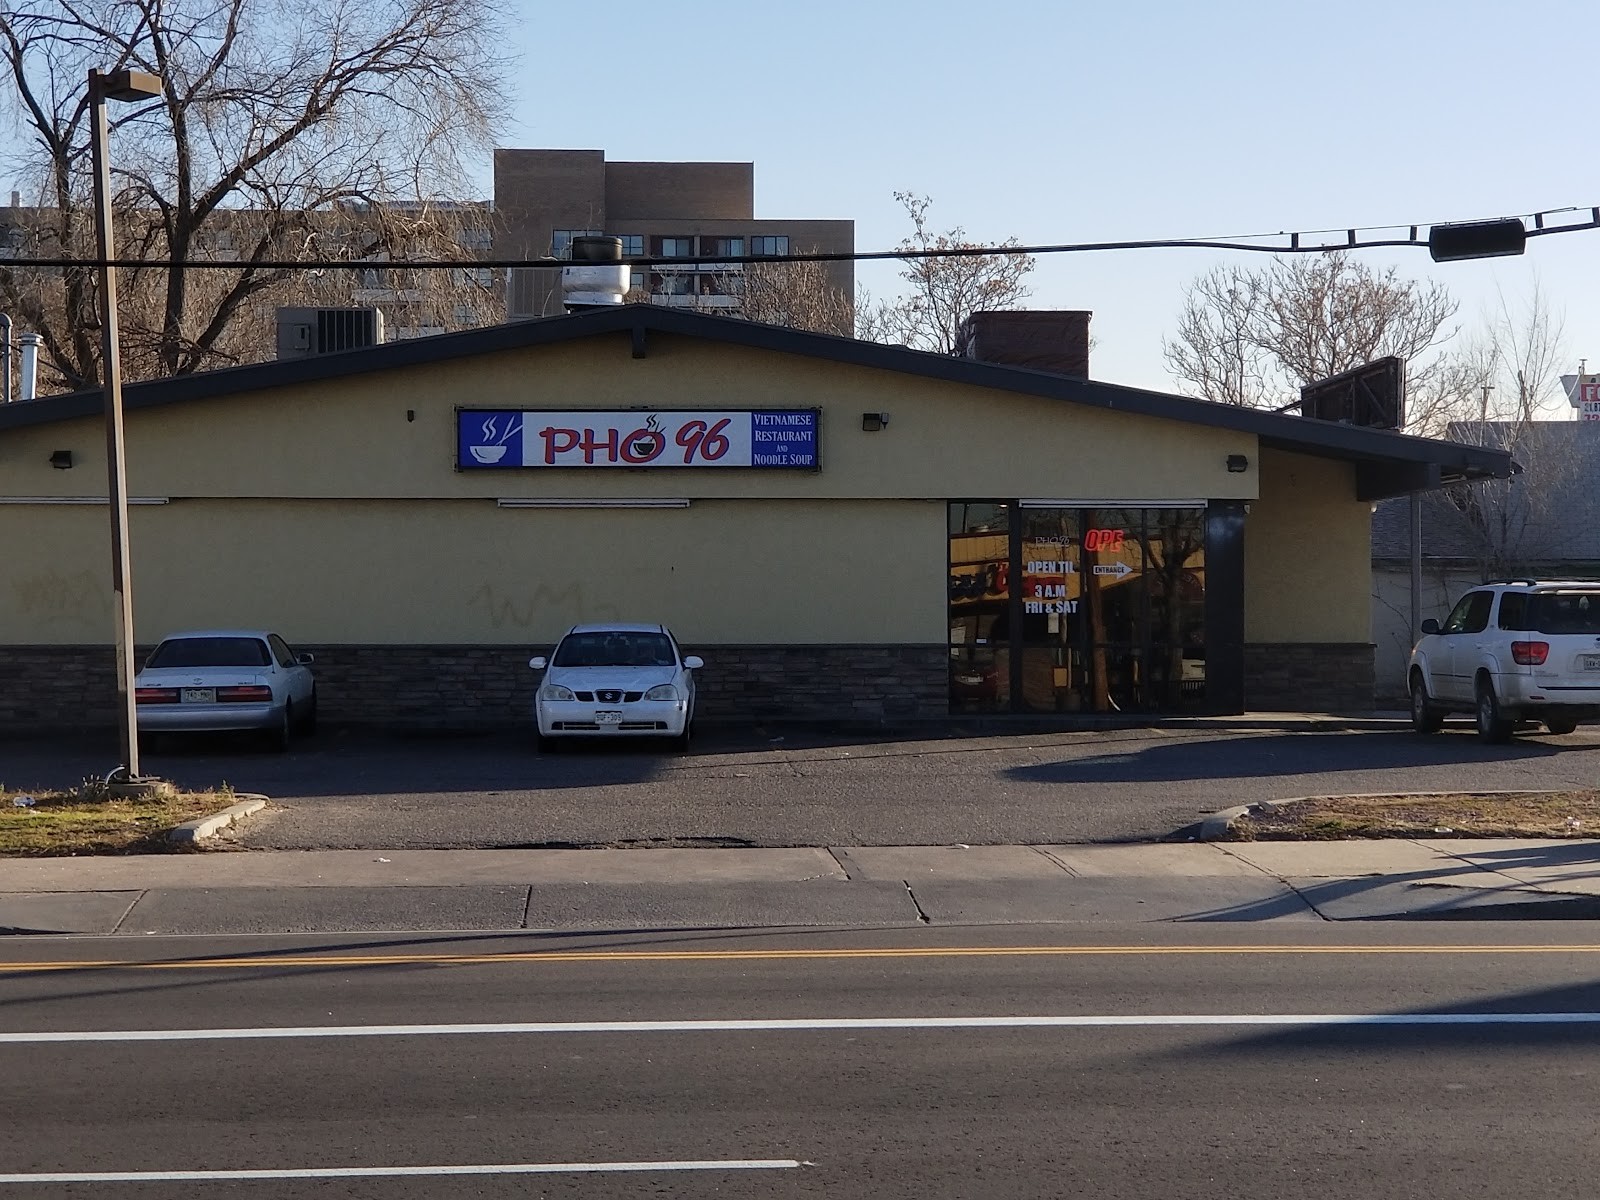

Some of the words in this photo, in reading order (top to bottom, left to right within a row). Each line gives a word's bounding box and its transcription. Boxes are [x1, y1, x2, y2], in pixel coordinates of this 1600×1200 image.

[754, 414, 812, 426] VIETNAMESE
[539, 426, 665, 465] PHO
[675, 418, 731, 464] 96
[755, 430, 813, 442] RESTAURANT
[754, 454, 788, 465] NOODLE
[790, 453, 813, 465] SOUP
[1027, 561, 1058, 574] OPEN
[1059, 561, 1075, 574] TIL
[1095, 566, 1125, 574] ENTRANCE
[1034, 584, 1042, 598] 3
[1044, 584, 1066, 598] A.M
[1025, 601, 1042, 614] FRI
[1045, 602, 1054, 614] &
[1055, 601, 1078, 614] SAT
